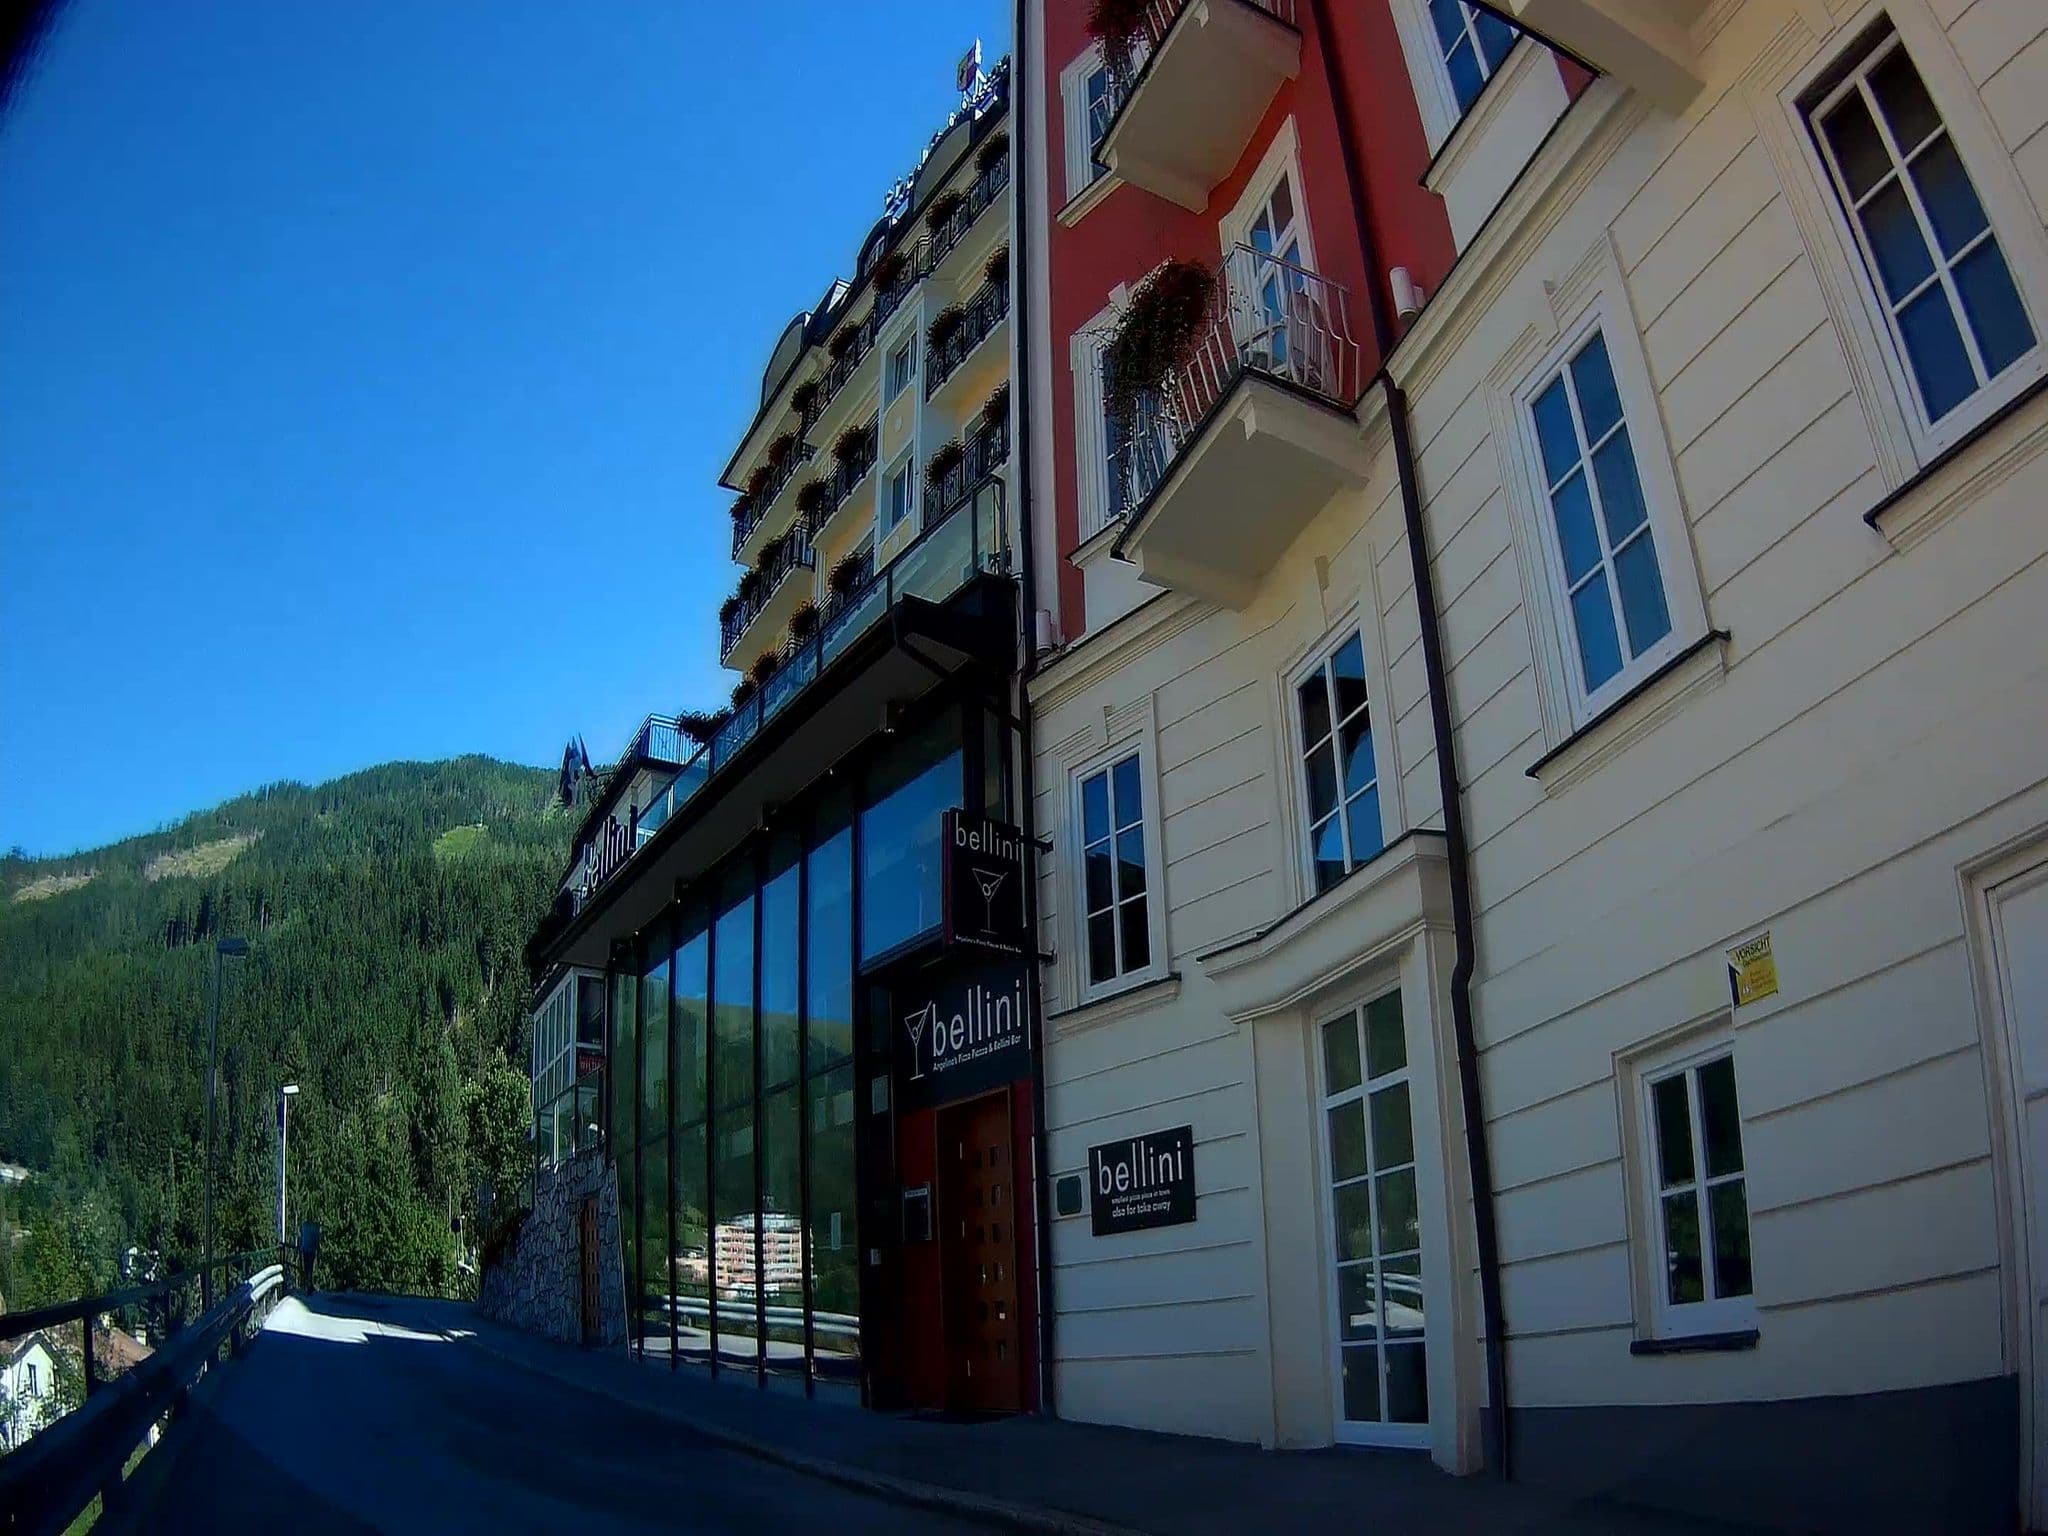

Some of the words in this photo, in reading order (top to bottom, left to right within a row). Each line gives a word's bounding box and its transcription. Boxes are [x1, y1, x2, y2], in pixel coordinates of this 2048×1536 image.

[955, 812, 1020, 862] bellini
[932, 979, 1021, 1057] bellini
[1097, 1140, 1183, 1195] bellini
[1112, 1206, 1125, 1218] also
[1127, 1204, 1136, 1215] for
[1137, 1202, 1151, 1214] take
[1152, 1201, 1171, 1212] away
